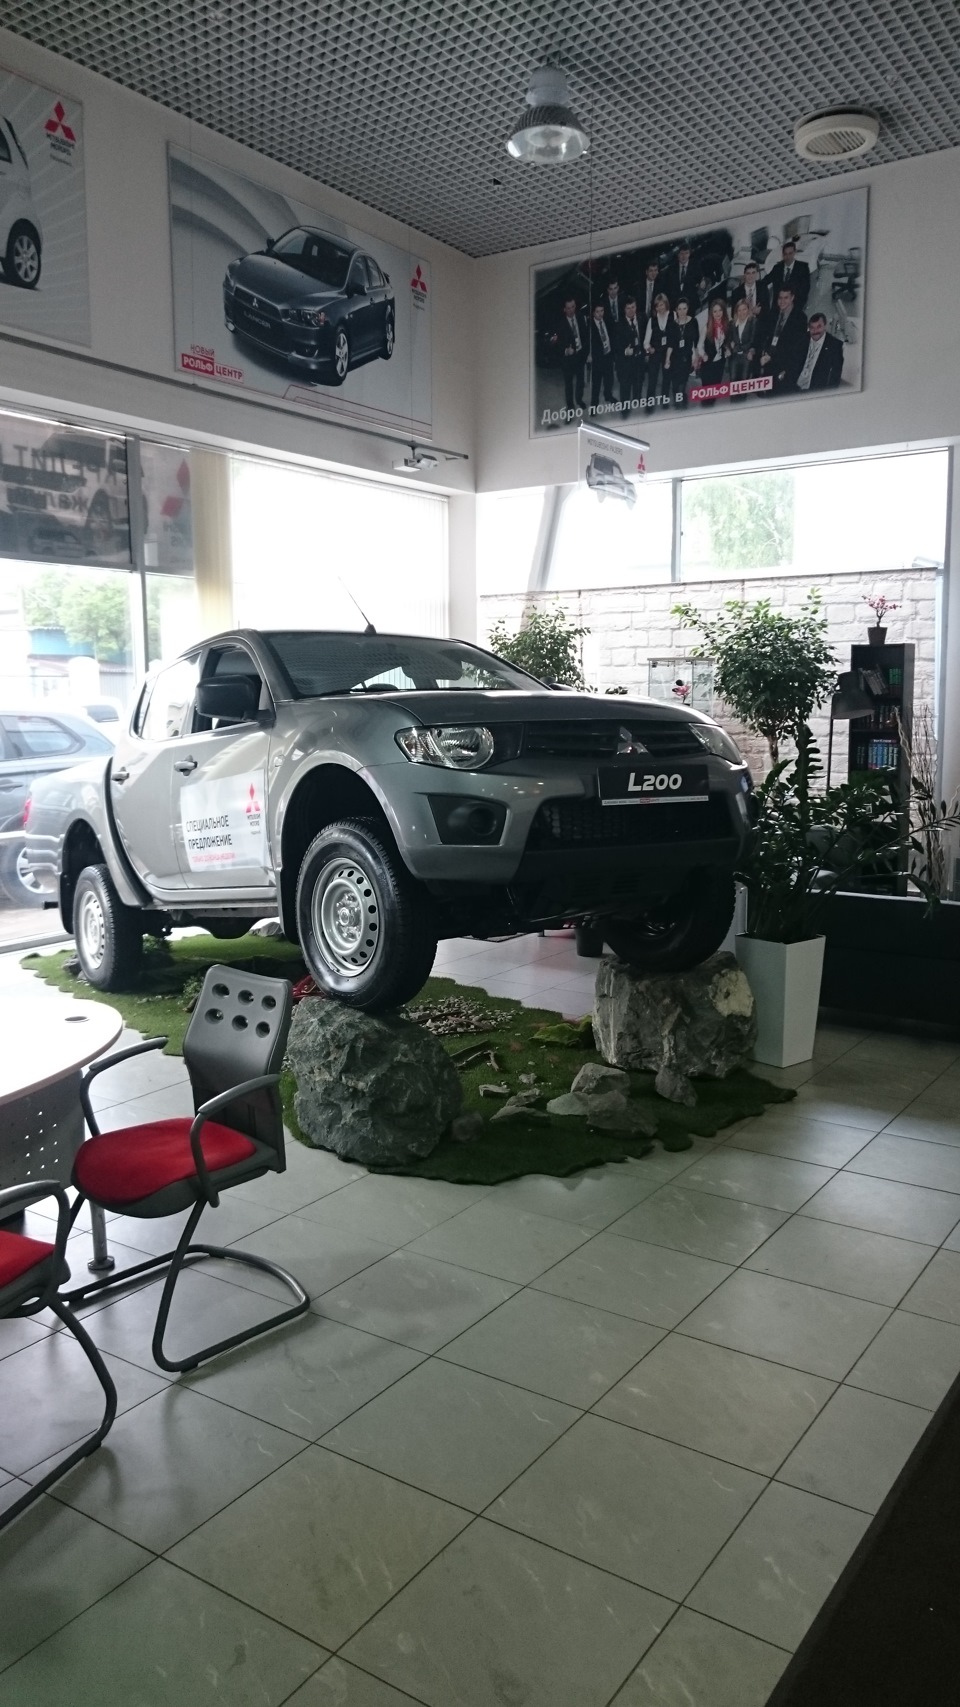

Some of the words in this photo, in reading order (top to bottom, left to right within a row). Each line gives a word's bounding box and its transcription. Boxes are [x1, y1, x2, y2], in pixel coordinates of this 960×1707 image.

[190, 343, 215, 356] НОВЫЙ
[183, 356, 214, 372] РОЛЬФ
[216, 365, 243, 380] ЦЕНТР
[541, 408, 583, 425] Добро
[588, 394, 671, 417] пожаловать
[675, 392, 684, 403] в
[692, 385, 729, 400] РОЛЬФ
[731, 378, 770, 395] ЦЕНТР
[628, 772, 682, 792] L200
[186, 814, 230, 833] СПЕЦИАЛЬНОЕ
[188, 833, 233, 851] ПРЕДЛОЖЕНИЕ
